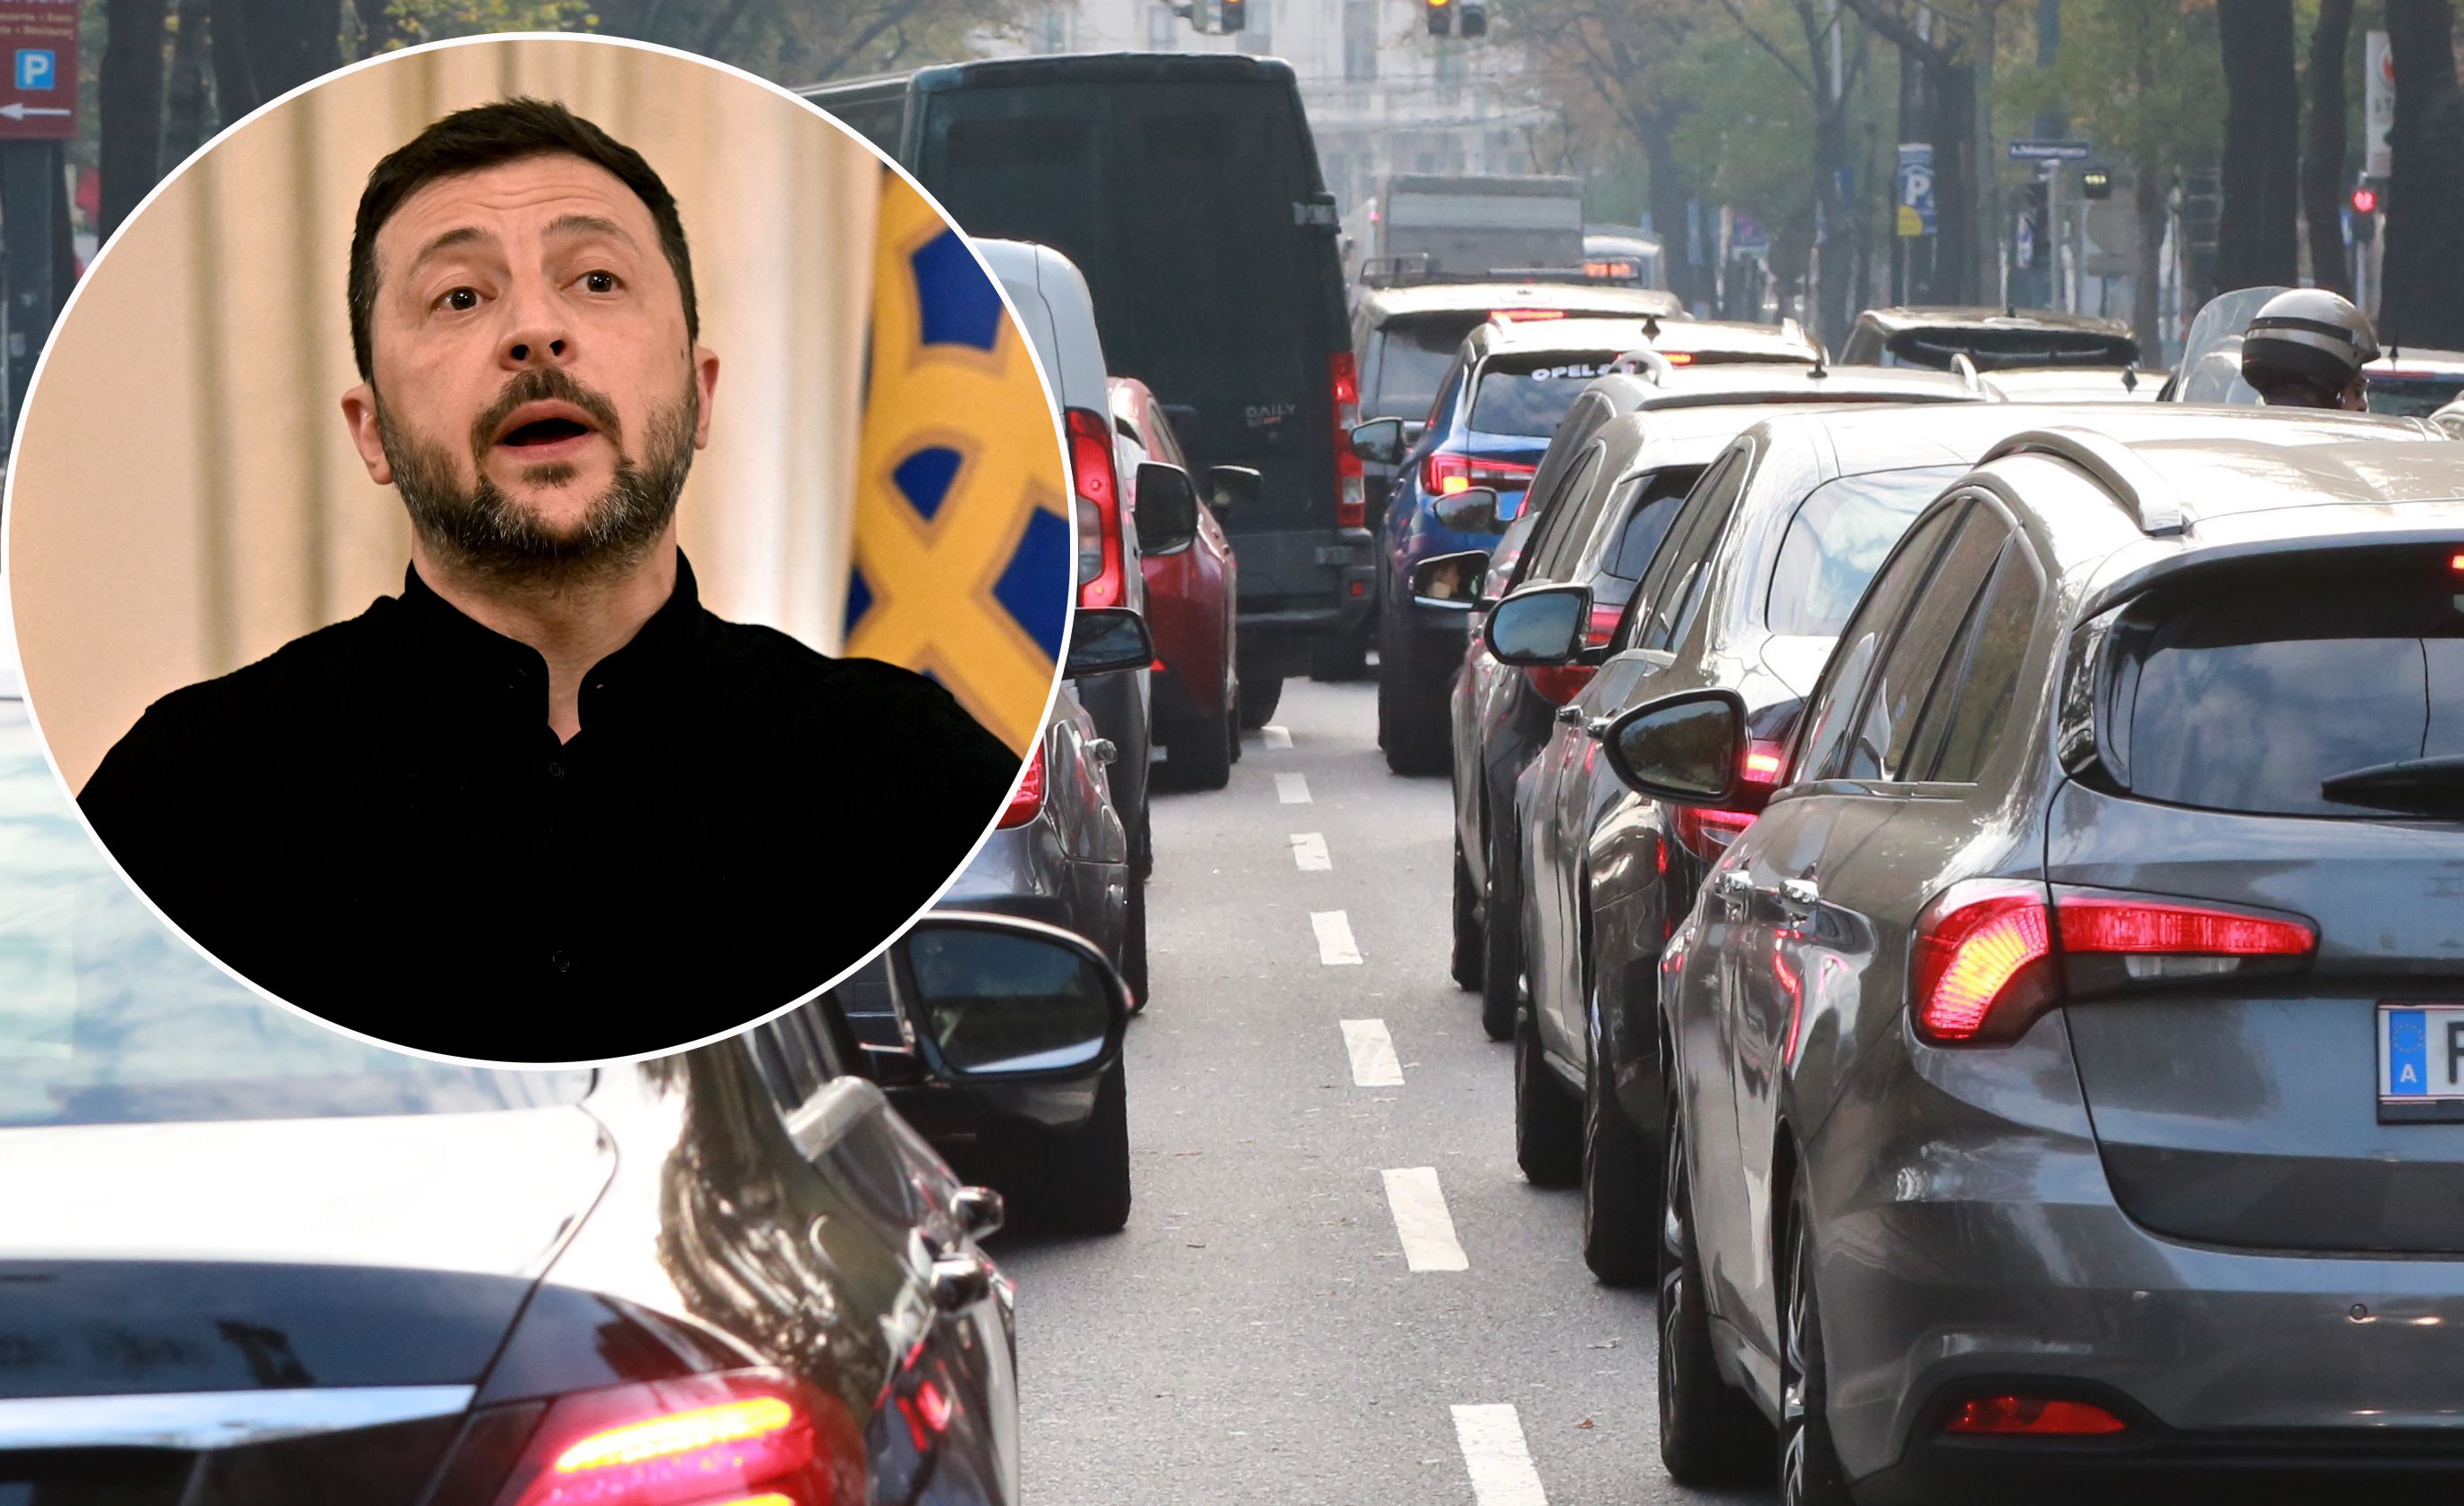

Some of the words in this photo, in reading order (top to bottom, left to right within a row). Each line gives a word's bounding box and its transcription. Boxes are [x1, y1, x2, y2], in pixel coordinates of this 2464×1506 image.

[25, 55, 49, 85] P
[1906, 174, 1930, 206] P
[1531, 363, 1594, 381] OPEL
[1245, 404, 1296, 418] DAILY
[2400, 1063, 2417, 1083] A
